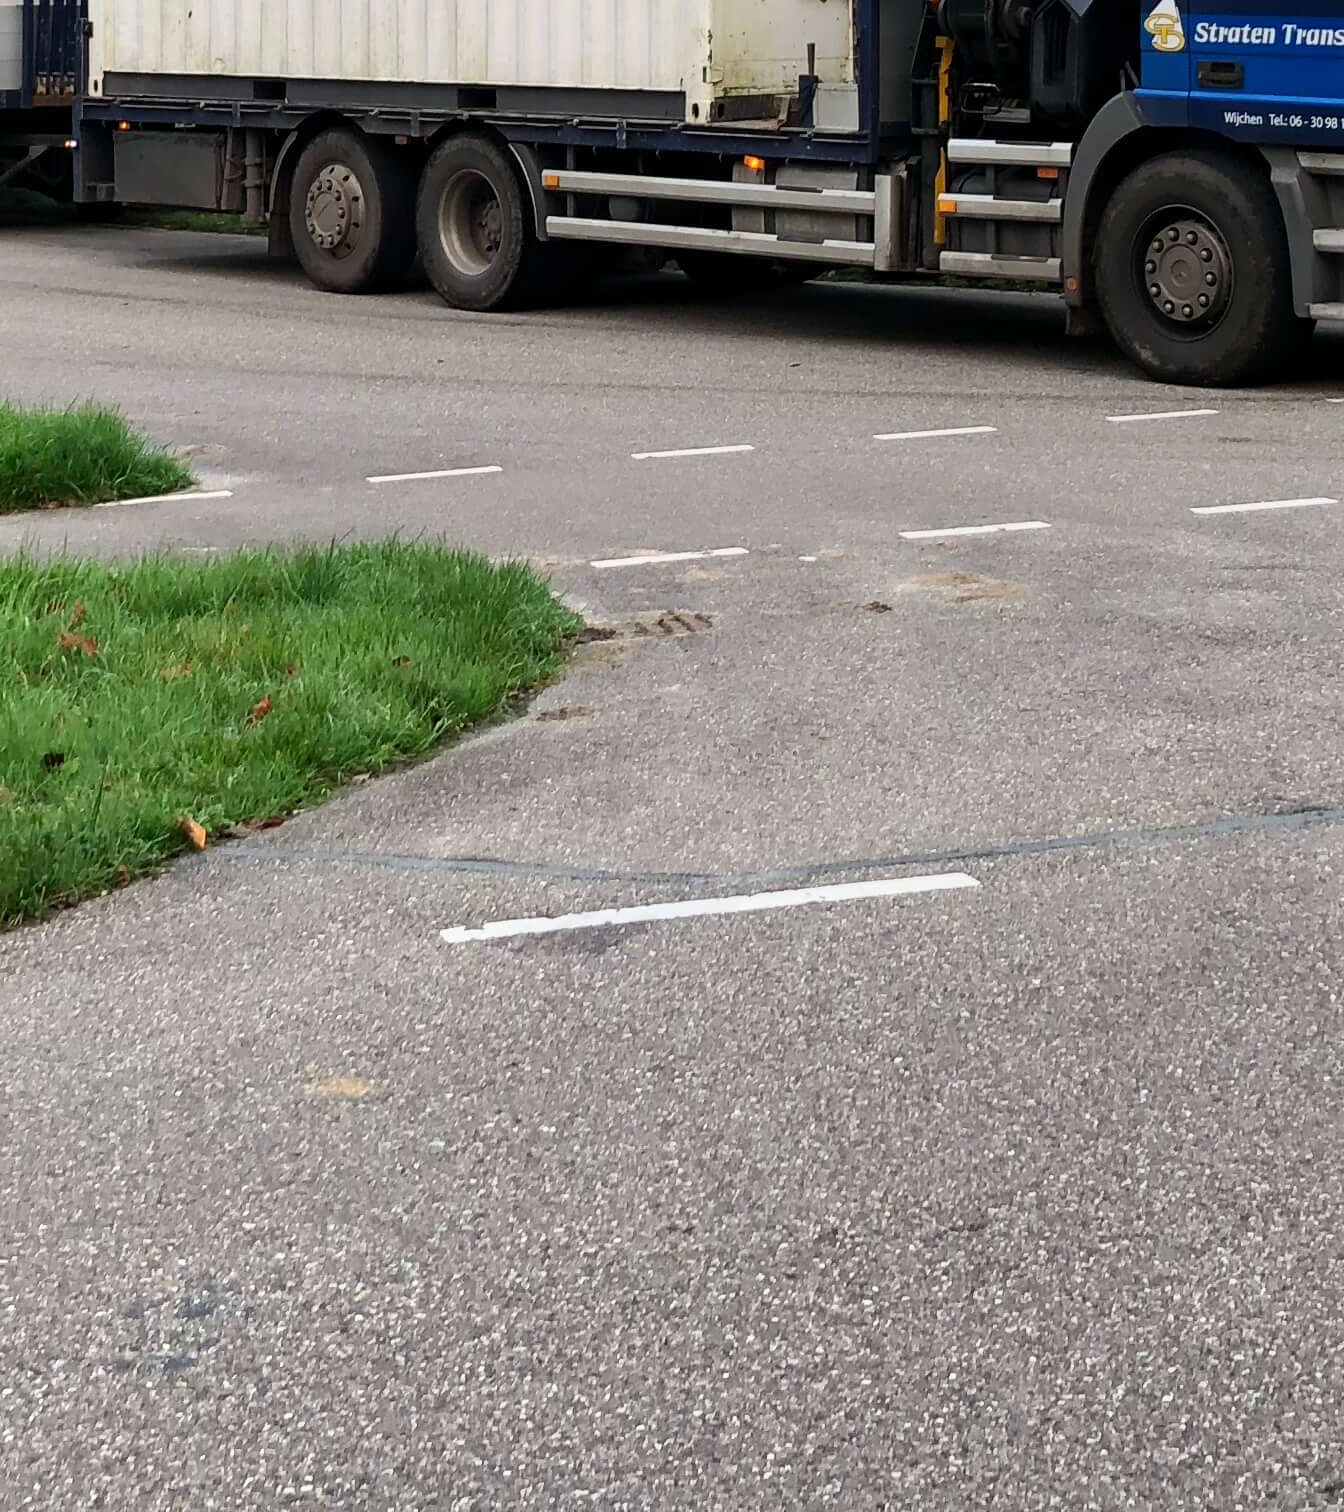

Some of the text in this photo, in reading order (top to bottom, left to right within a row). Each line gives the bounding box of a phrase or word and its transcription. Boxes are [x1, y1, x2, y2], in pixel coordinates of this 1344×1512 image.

[1194, 21, 1276, 45] Straten
[1223, 111, 1263, 127] Wijchen
[1288, 115, 1303, 127] 06
[1309, 116, 1323, 129] 30
[1324, 117, 1338, 129] 98
